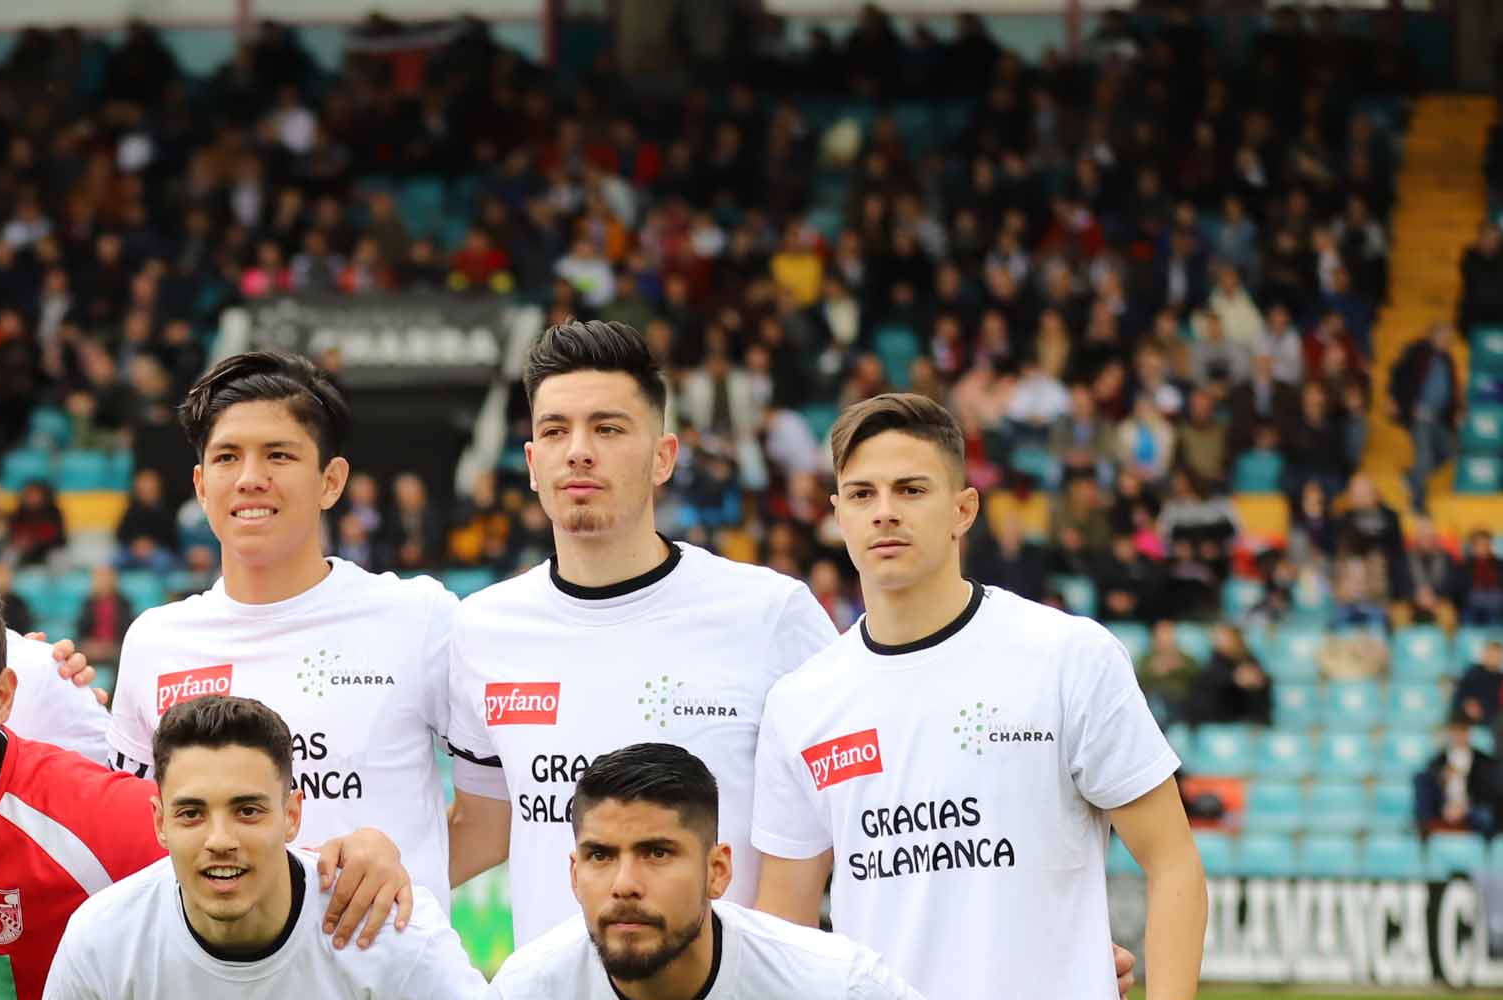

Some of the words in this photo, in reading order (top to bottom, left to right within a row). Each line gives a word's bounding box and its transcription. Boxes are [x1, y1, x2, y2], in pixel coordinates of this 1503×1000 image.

[159, 675, 229, 709] pyfano
[331, 675, 395, 685] CHARRA
[485, 689, 556, 721] pyfano
[673, 705, 738, 717] CHARRA
[989, 732, 1055, 742] CHARRA
[811, 743, 877, 786] pyfano
[861, 797, 981, 838] GRACIAS
[849, 838, 1015, 880] SALAMANCA
